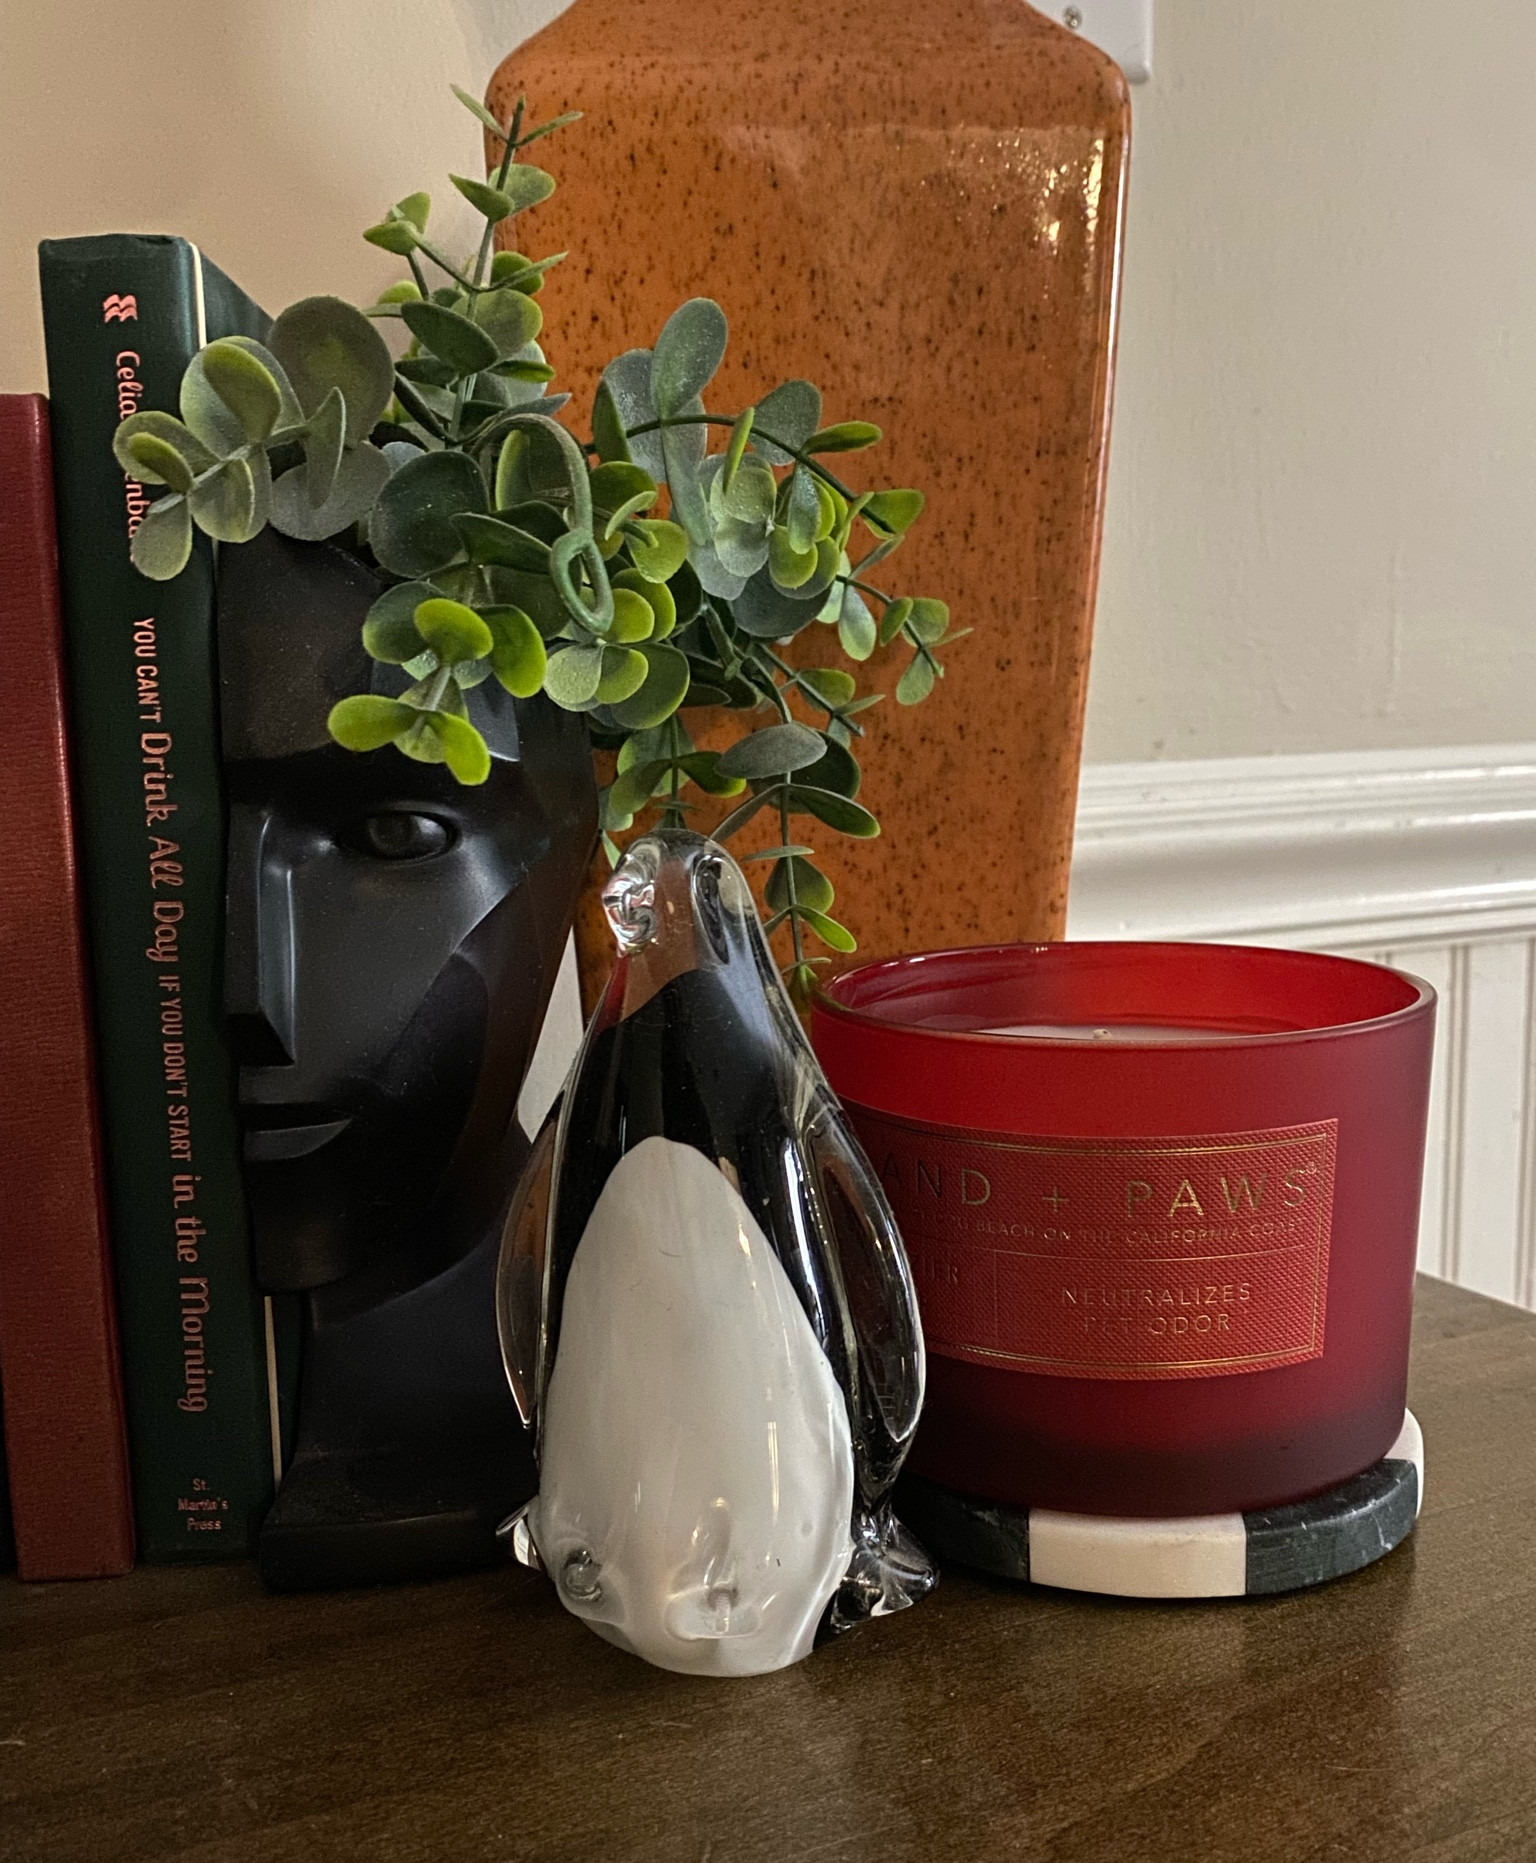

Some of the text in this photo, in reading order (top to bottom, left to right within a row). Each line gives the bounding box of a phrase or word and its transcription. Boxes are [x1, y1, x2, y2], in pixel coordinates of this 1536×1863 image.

[115, 350, 144, 420] Celia
[133, 617, 215, 1413] YOU CAN'T Drink All Day IF YOU DON'T START in the Morning
[879, 1151, 992, 1206] AND
[976, 1220, 1034, 1239] BEACH
[1062, 1282, 1252, 1307] NEUTRALIZES
[1150, 1313, 1231, 1335] ODOR
[187, 1517, 222, 1531] Press
